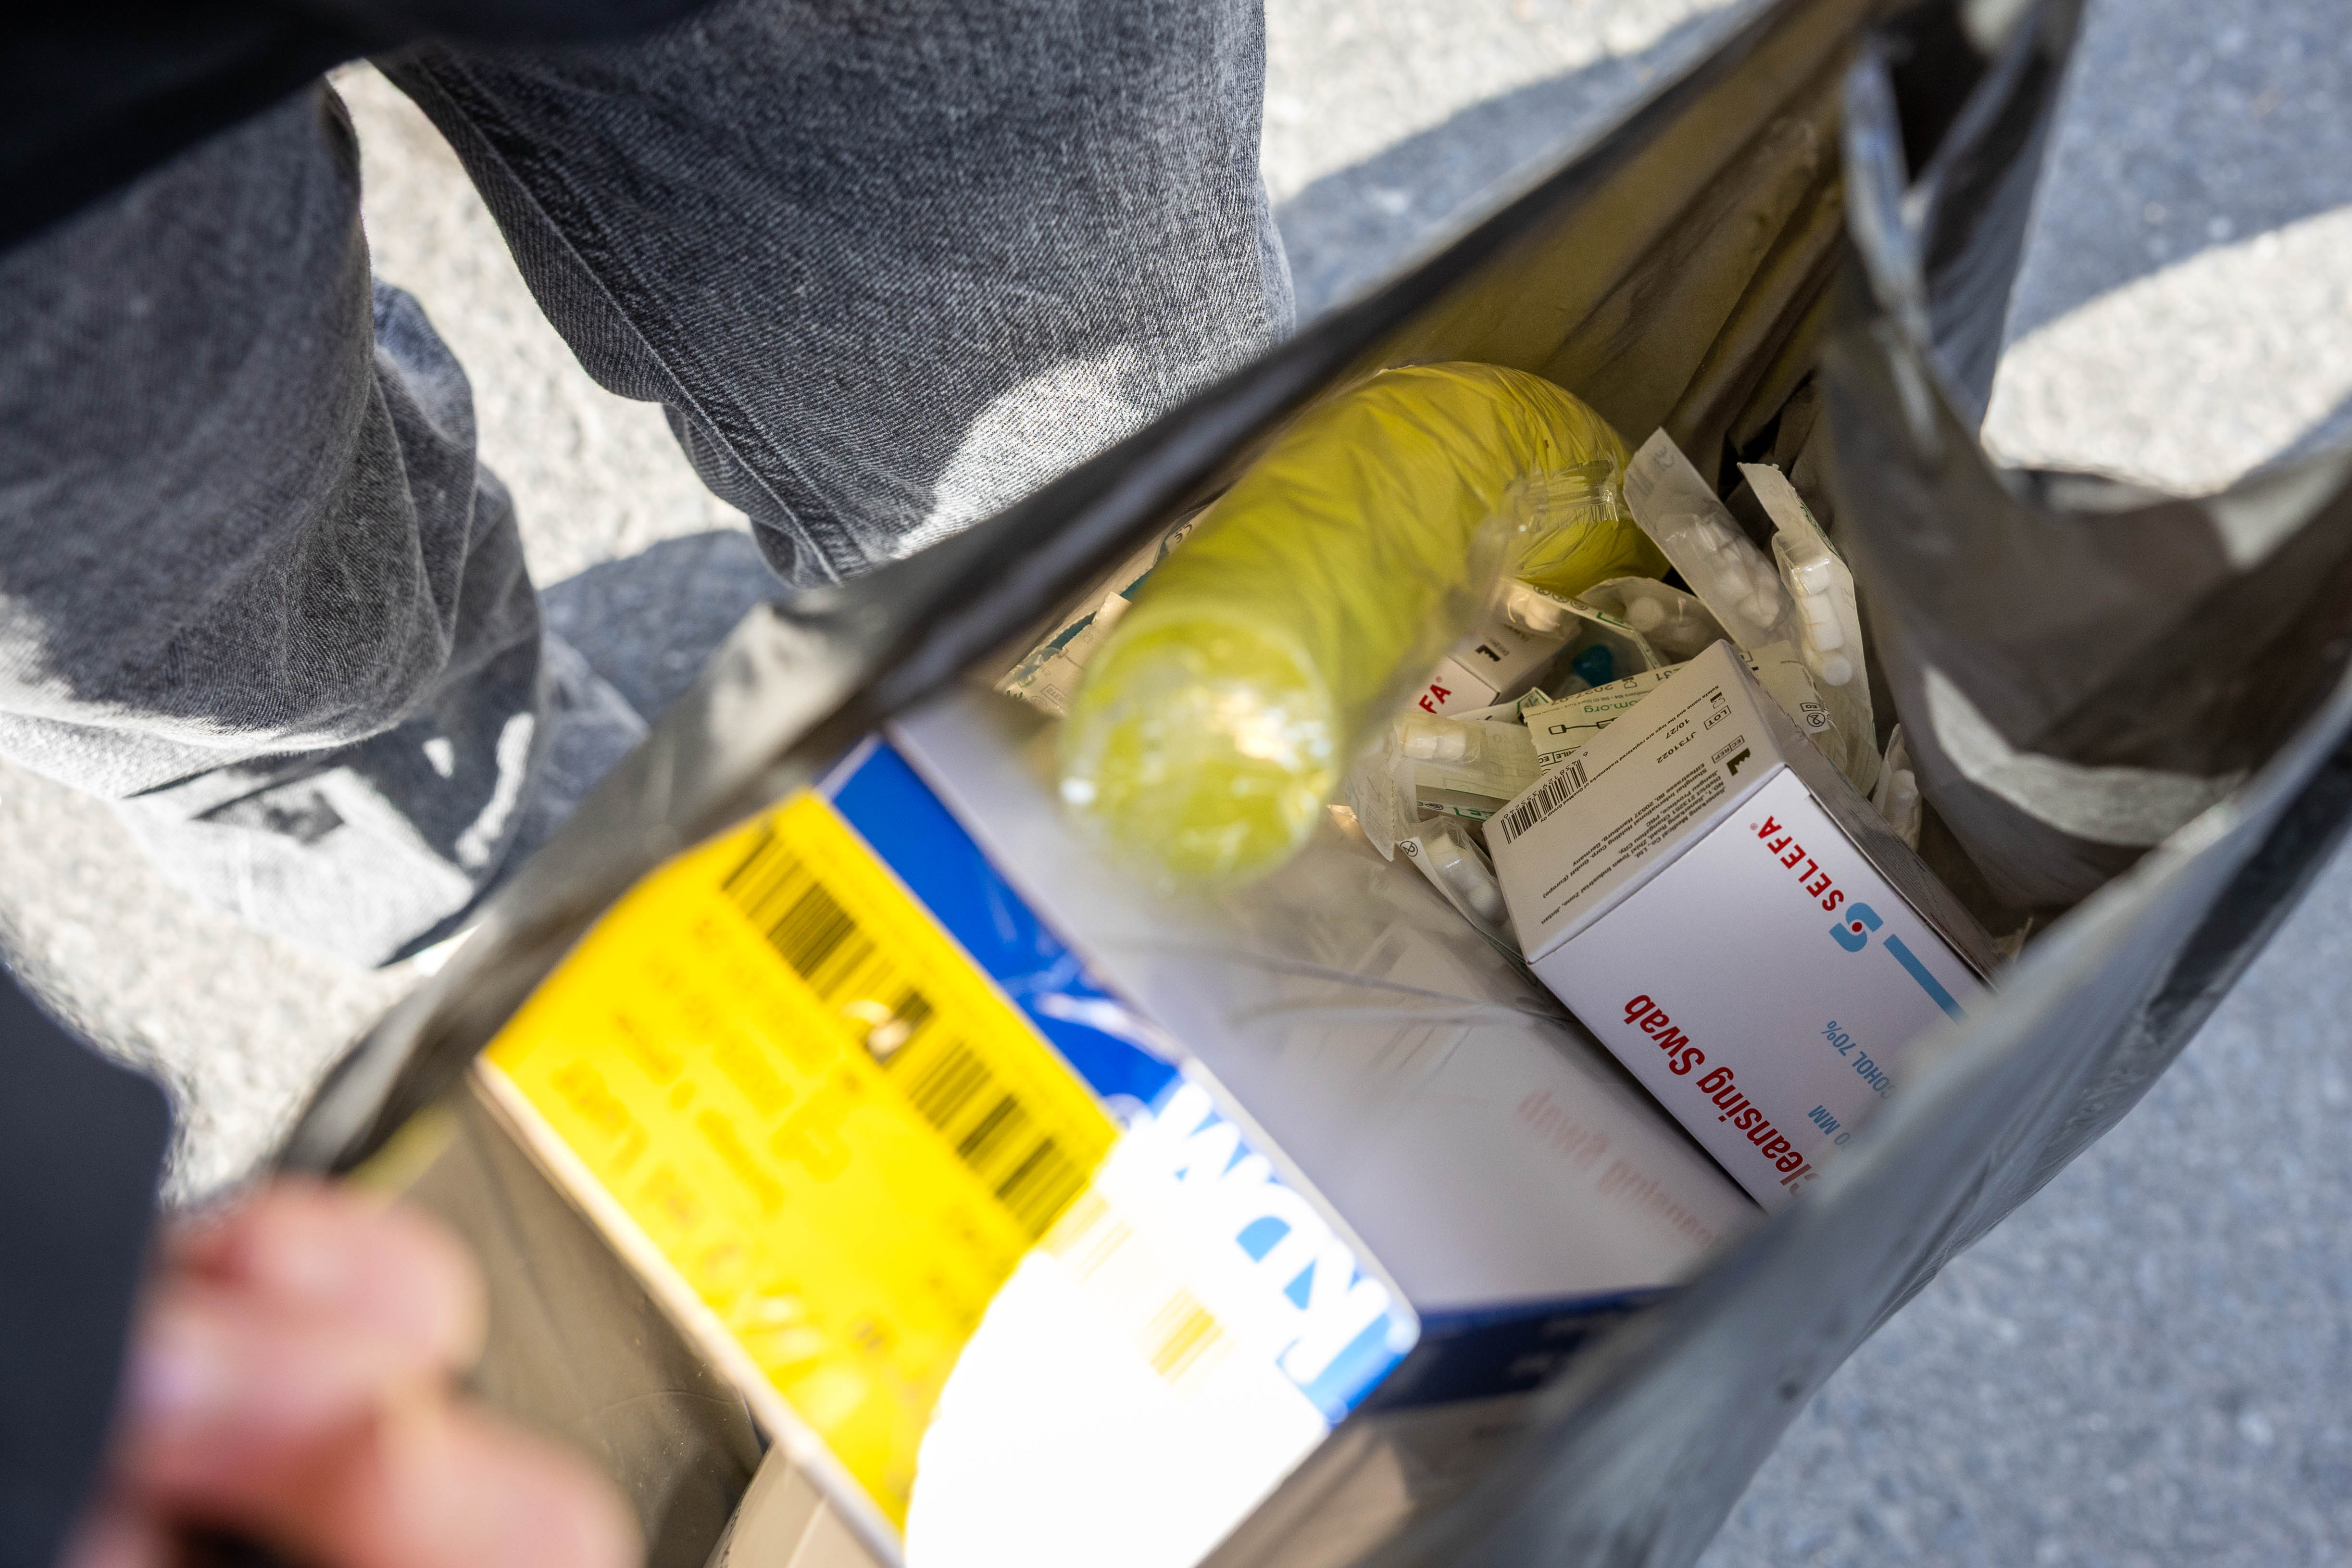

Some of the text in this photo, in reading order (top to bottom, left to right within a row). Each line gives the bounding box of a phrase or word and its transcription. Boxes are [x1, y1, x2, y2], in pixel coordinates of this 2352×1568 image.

[1655, 668, 1681, 681] 31
[1583, 700, 1639, 714] om.org
[1708, 709, 1727, 727] LOT
[1665, 718, 1690, 740] 10/27
[1656, 731, 1696, 764] JT31022
[1714, 738, 1741, 760] EC REP
[1542, 760, 1577, 789] 438129
[1503, 790, 1538, 820] 355246
[1624, 994, 1705, 1075] Swab
[1821, 1021, 1856, 1056] 70%
[1807, 1105, 1840, 1135] MM
